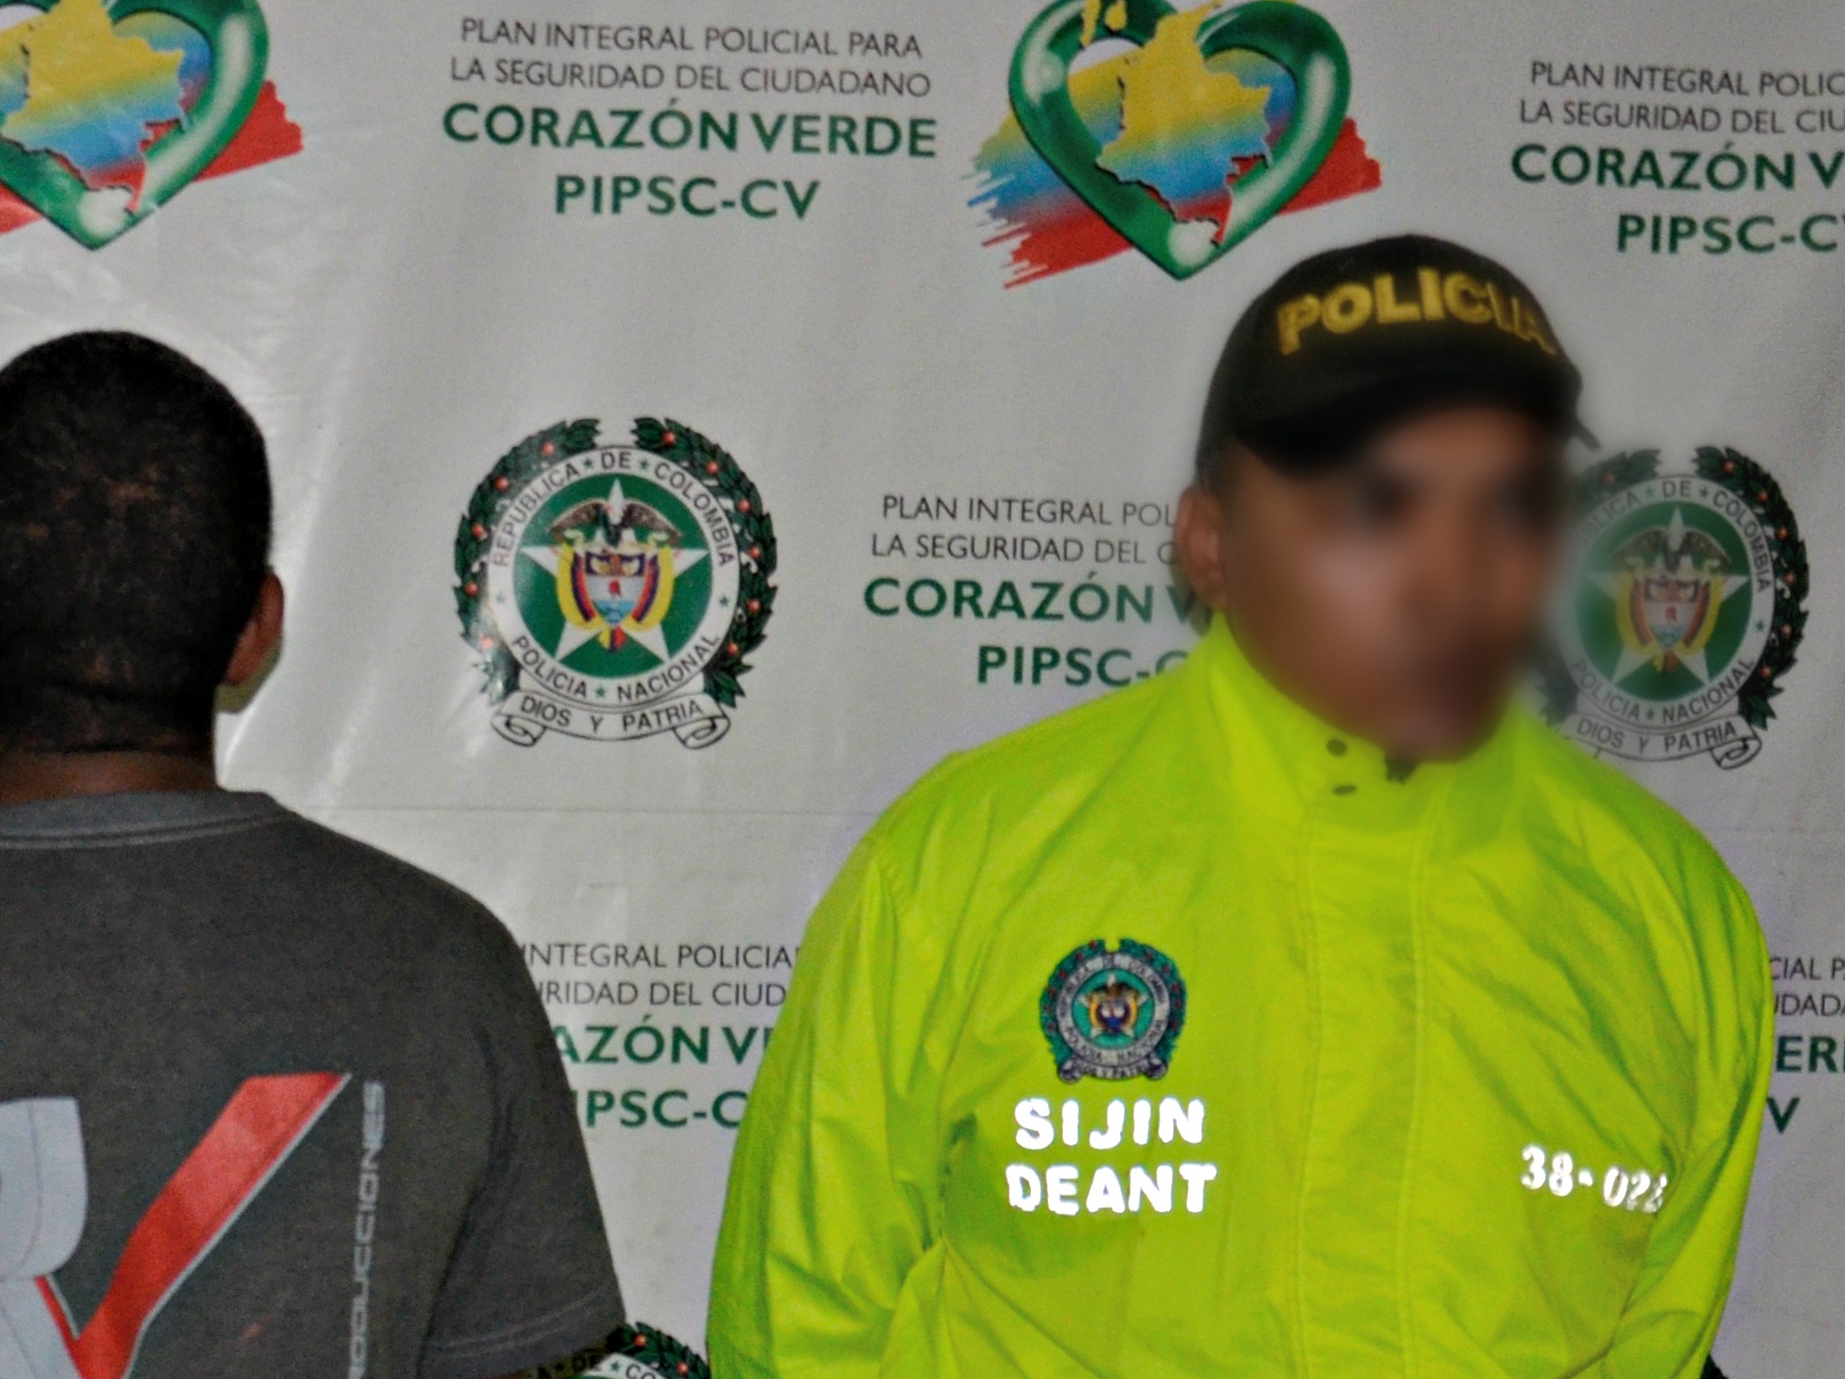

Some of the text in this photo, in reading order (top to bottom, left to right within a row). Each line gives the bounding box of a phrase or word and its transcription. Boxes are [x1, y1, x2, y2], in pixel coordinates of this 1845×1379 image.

[461, 17, 923, 58] PLAN INTEGRAL POLICIAL PARA
[451, 57, 931, 98] LA SEGURIDAD DEL CIUDADANO
[1531, 61, 1750, 96] PLAN INTEGRAL
[443, 98, 937, 157] CORAZÓN VERDE
[1521, 100, 1553, 123] LA
[1563, 101, 1722, 132] SEGURIDAD
[1731, 110, 1785, 134] DEL
[1512, 141, 1795, 191] CORAZÓN
[556, 174, 820, 219] PIPSC-CV
[1276, 266, 1556, 356] POLICIA
[494, 452, 735, 567] REPUBLICA DE COLOMBIA
[882, 496, 957, 520] PLAN
[969, 498, 1112, 525] INTEGRAL
[872, 534, 905, 557] LA
[916, 534, 1084, 562] SEGURIDAD
[1095, 541, 1147, 564] DEL
[1662, 481, 1772, 593] DE COLOMBIA
[865, 572, 1154, 622] CORAZÓN
[513, 635, 718, 701] POLICIA NACIONAL
[521, 696, 702, 731] DIOS PATRIA
[1573, 660, 1754, 724] POLICIA NACIONAL
[1577, 719, 1736, 752] DIOS PATRIA
[650, 982, 701, 1006] DEL
[1013, 1096, 1205, 1150] SIJIN
[1004, 1161, 1218, 1215] DEANT
